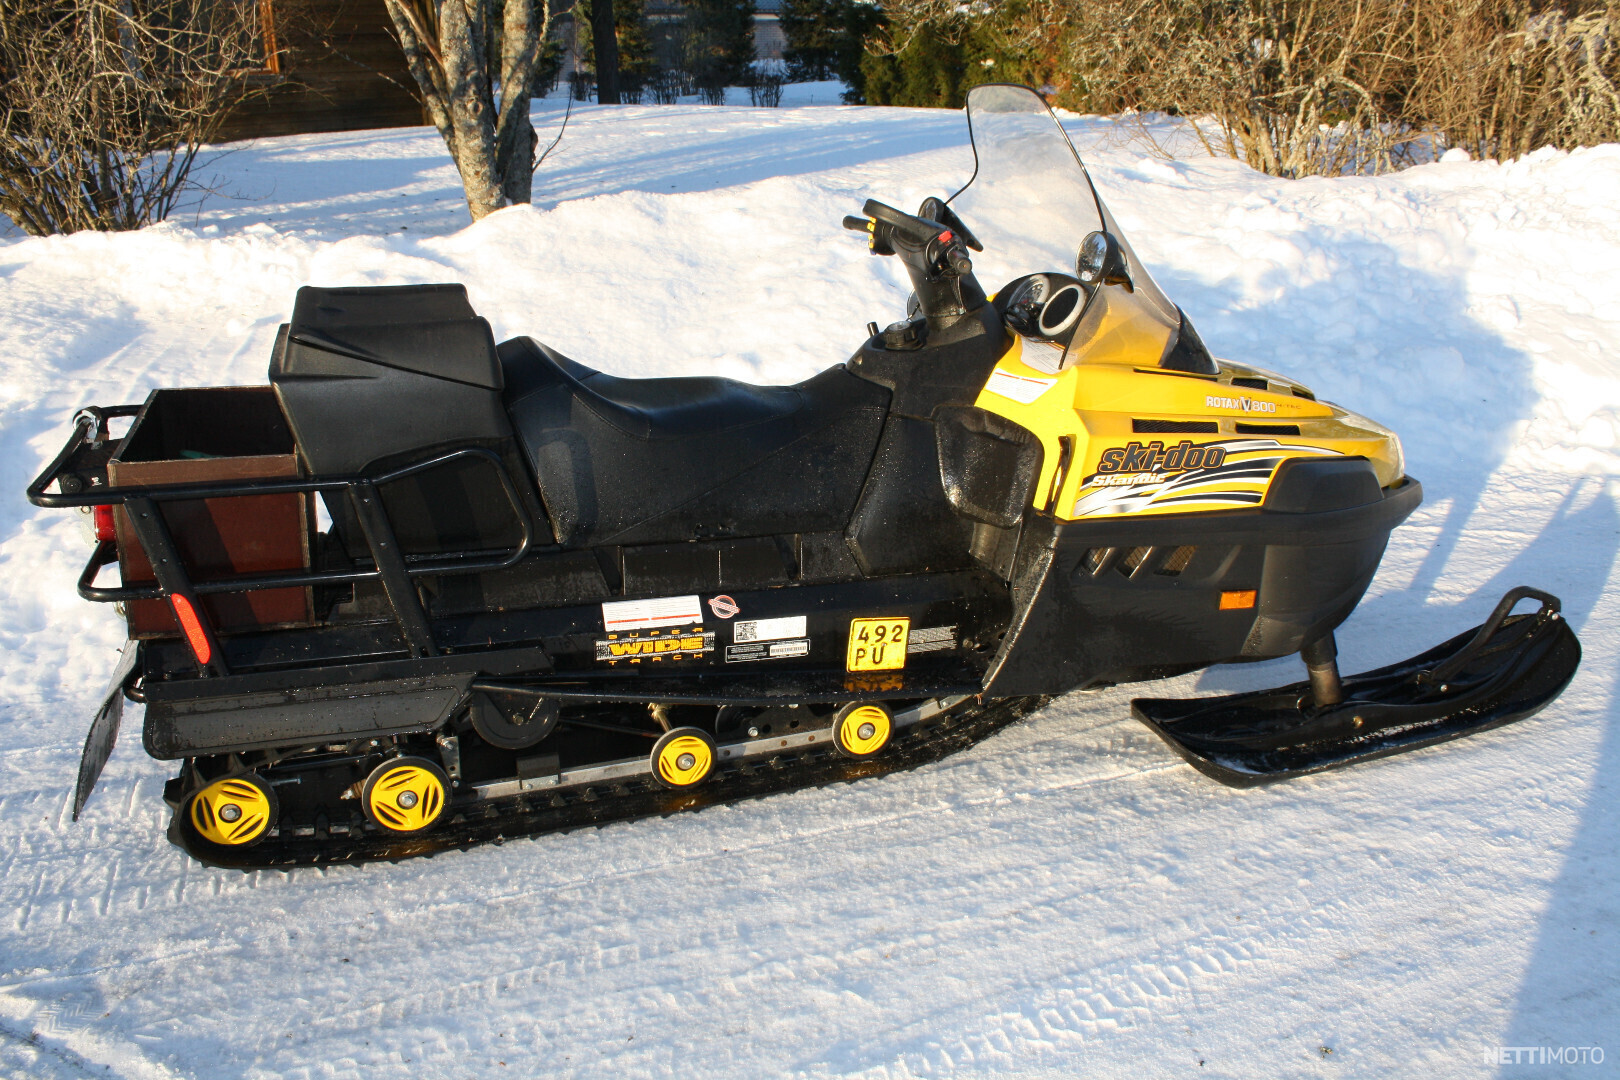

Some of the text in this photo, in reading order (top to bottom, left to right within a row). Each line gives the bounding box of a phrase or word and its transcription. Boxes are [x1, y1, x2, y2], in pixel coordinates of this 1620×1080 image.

[1099, 441, 1227, 473] ski-doo
[1092, 472, 1167, 488] Skandic
[857, 624, 903, 644] 492
[608, 636, 704, 656] WIDE
[855, 645, 885, 666] PU
